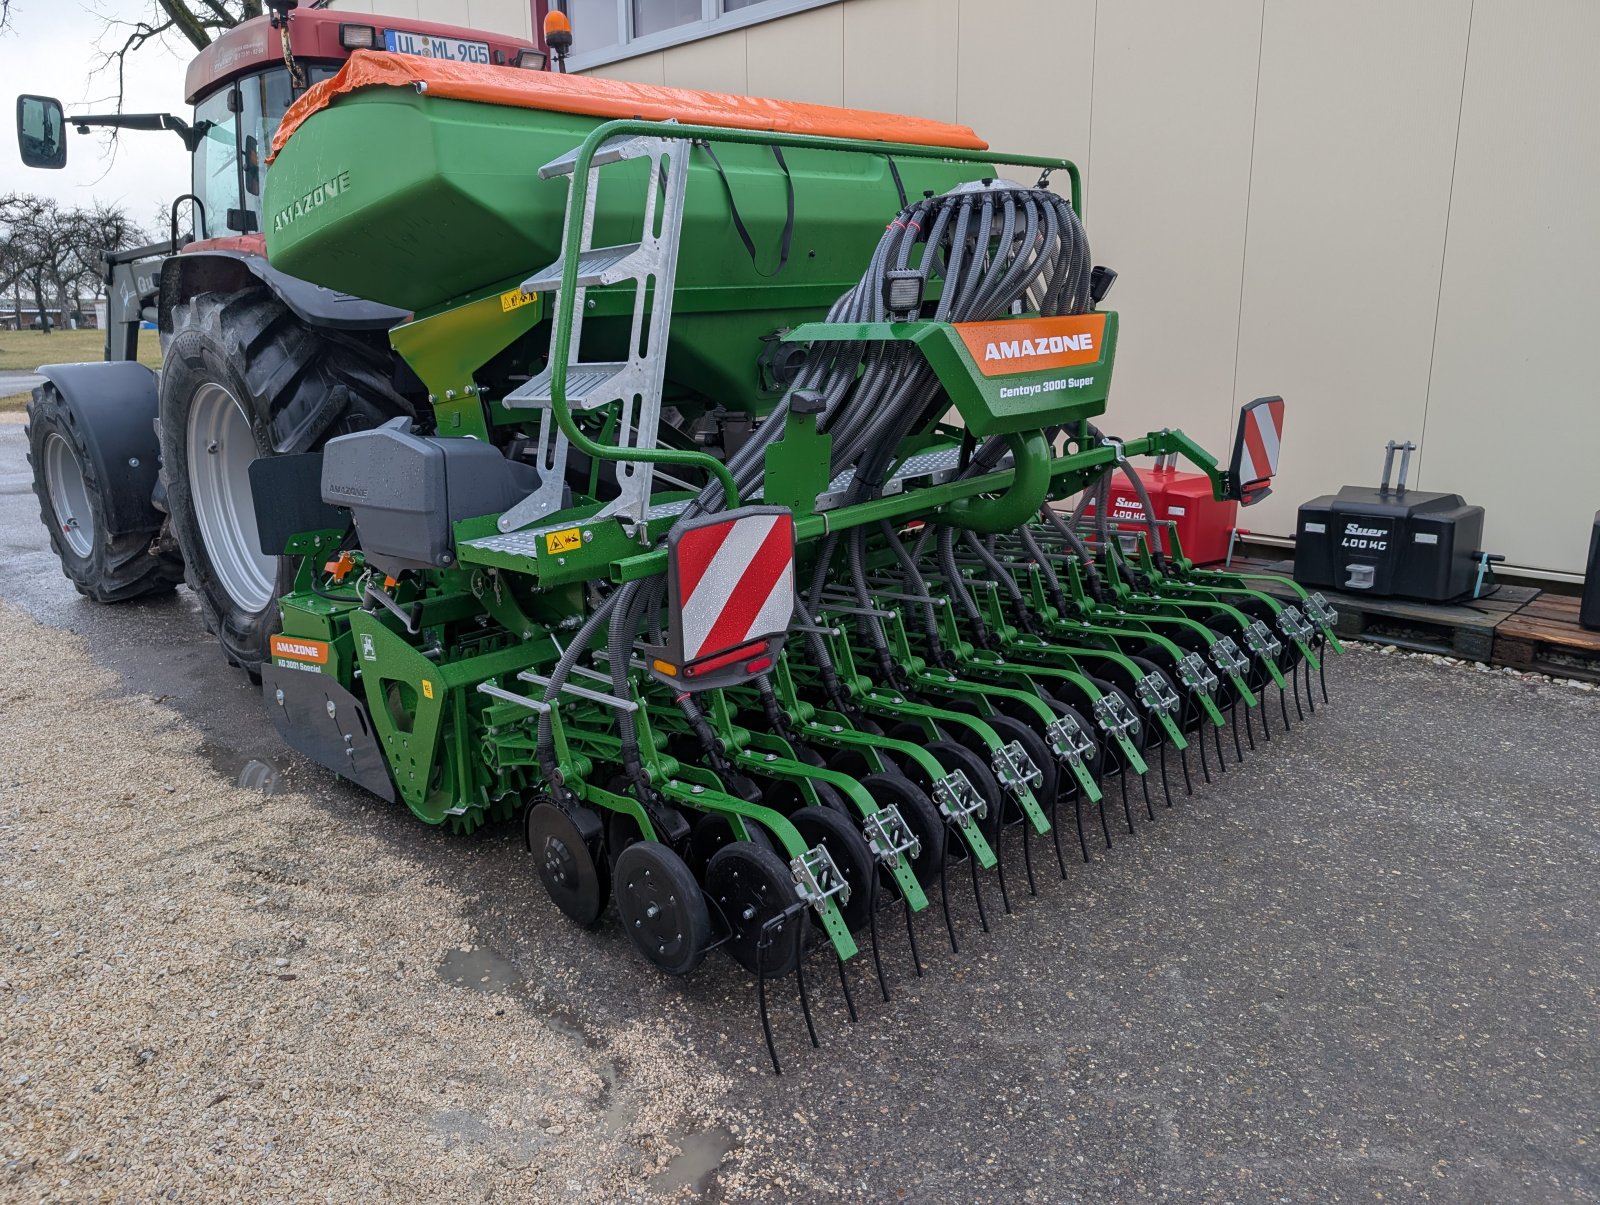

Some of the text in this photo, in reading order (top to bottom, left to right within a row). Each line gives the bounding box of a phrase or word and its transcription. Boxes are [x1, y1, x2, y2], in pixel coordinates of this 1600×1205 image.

[397, 34, 489, 64] UL ML 905
[274, 170, 351, 234] AMAZONE
[985, 333, 1093, 361] AMAZONE
[1000, 377, 1094, 398] Centaya 3000 Super
[329, 484, 368, 498] AMAZONE
[1115, 497, 1143, 509] Sue
[1113, 510, 1131, 519] 400
[1344, 523, 1388, 537] Suer
[1341, 537, 1388, 551] 400 KG
[276, 641, 319, 657] AMAZONE
